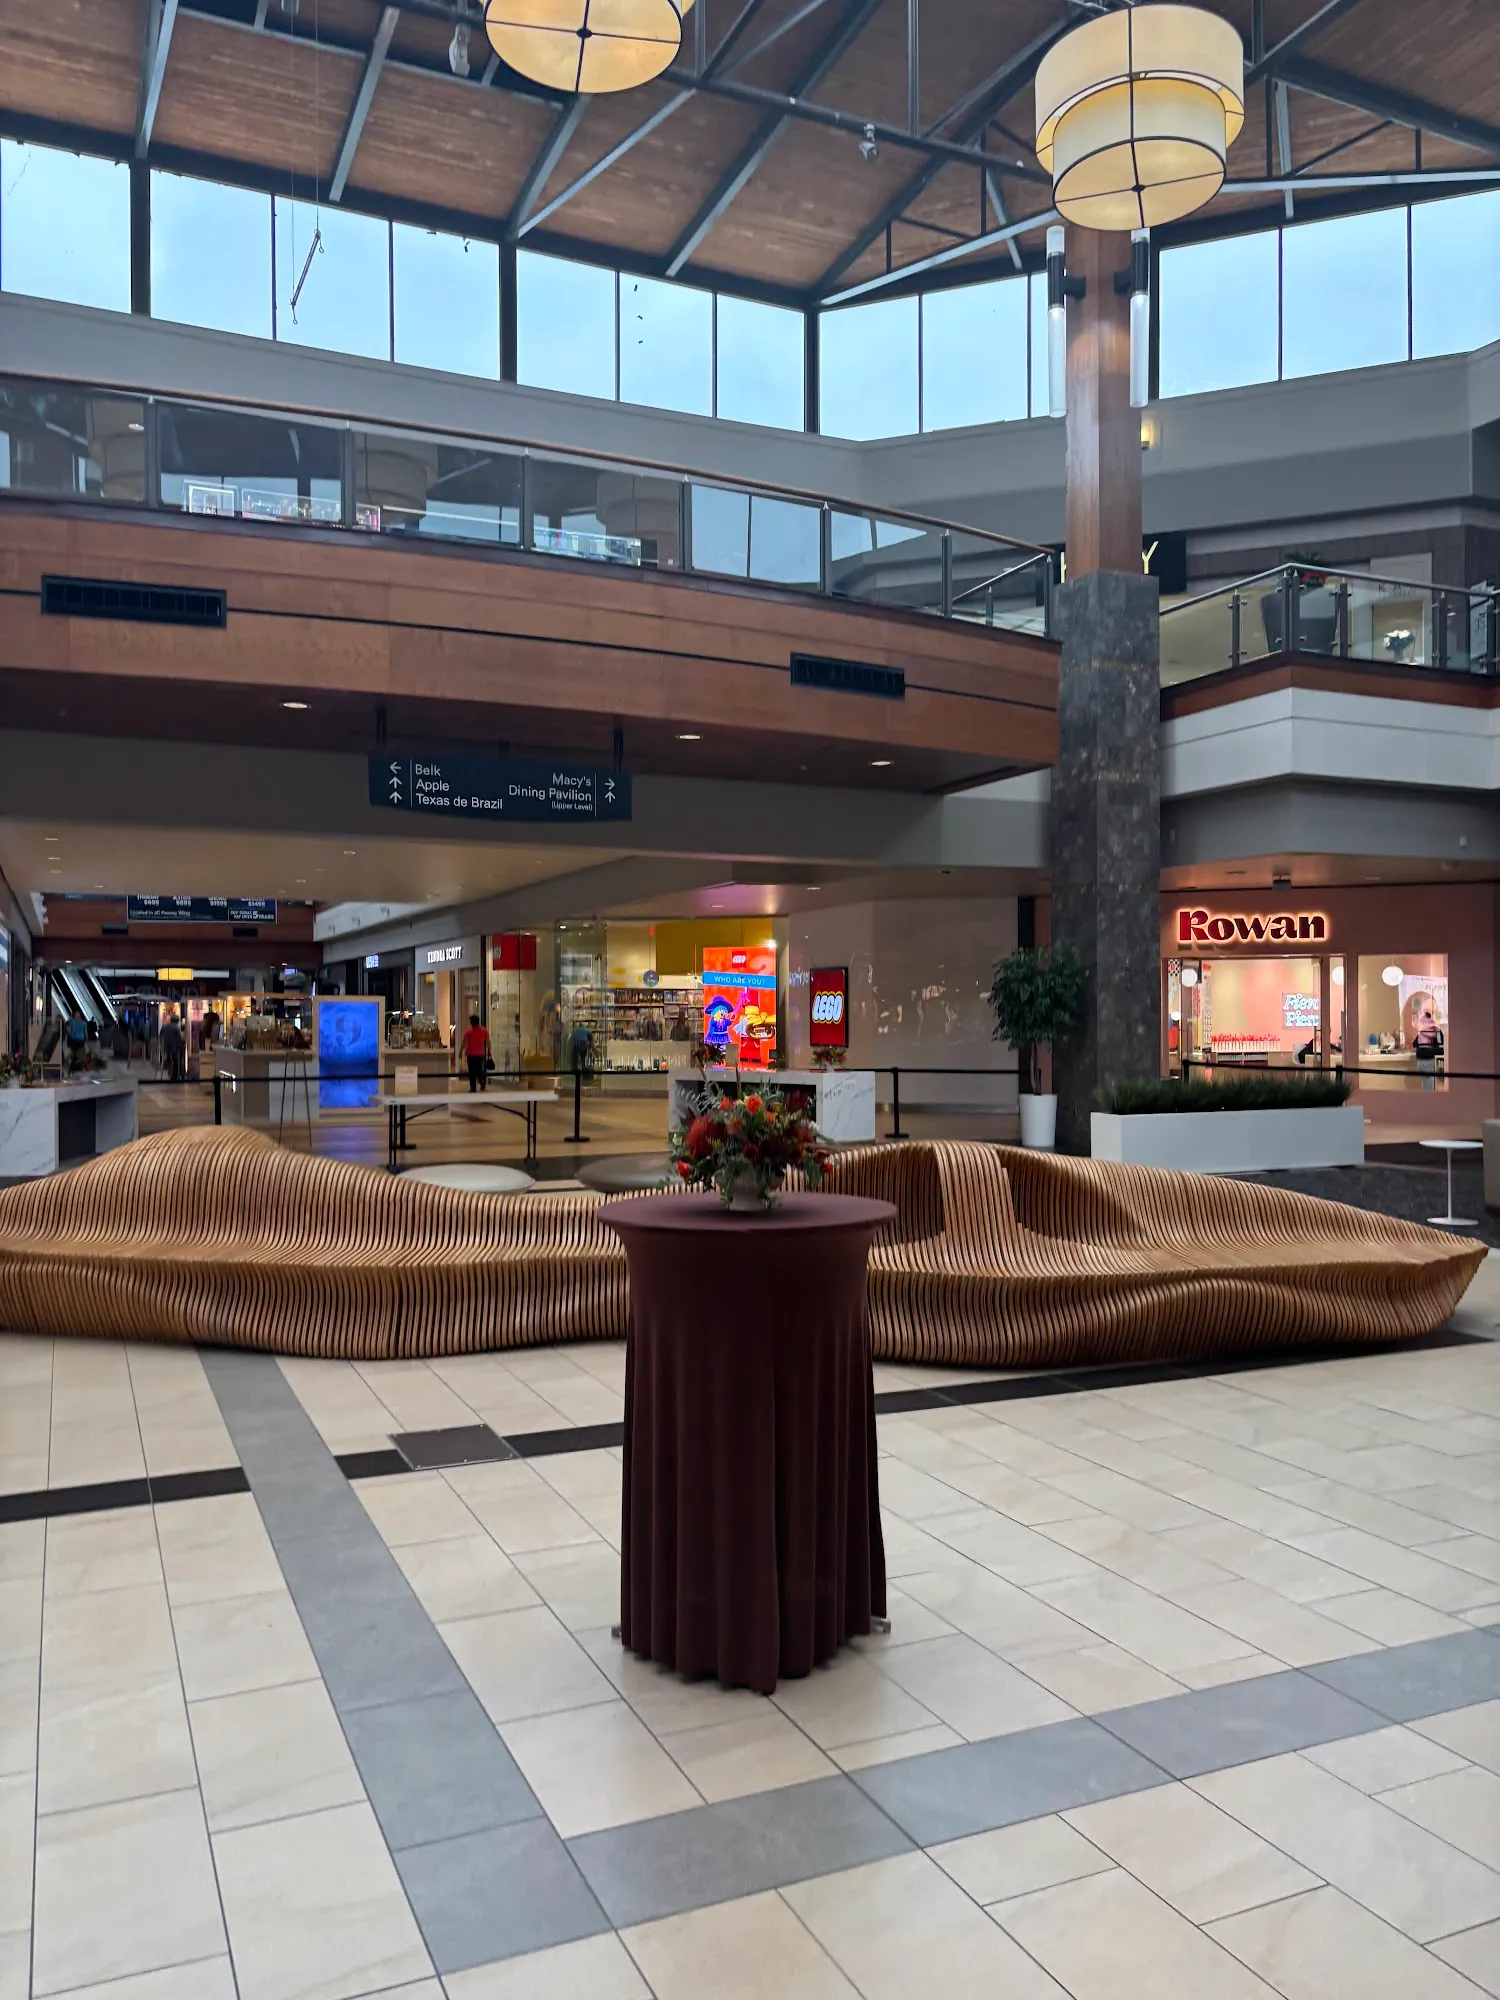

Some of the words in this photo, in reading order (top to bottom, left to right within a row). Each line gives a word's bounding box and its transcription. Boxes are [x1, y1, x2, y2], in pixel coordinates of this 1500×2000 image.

[415, 764, 441, 777] Belk
[416, 778, 450, 794] Apple
[552, 773, 592, 789] Macy's
[416, 793, 450, 806] Texas
[453, 795, 468, 808] de
[471, 797, 503, 810] Brazil
[508, 785, 546, 800] Dining
[549, 787, 592, 802] Pavilion
[551, 802, 573, 812] (Upper
[574, 803, 593, 812] Level)
[252, 910, 259, 919] 5
[1179, 910, 1325, 941] Rowan
[446, 946, 462, 961] SCOTT
[732, 976, 746, 984] ARE
[747, 977, 766, 986] YOU?
[812, 993, 844, 1023] LEGO
